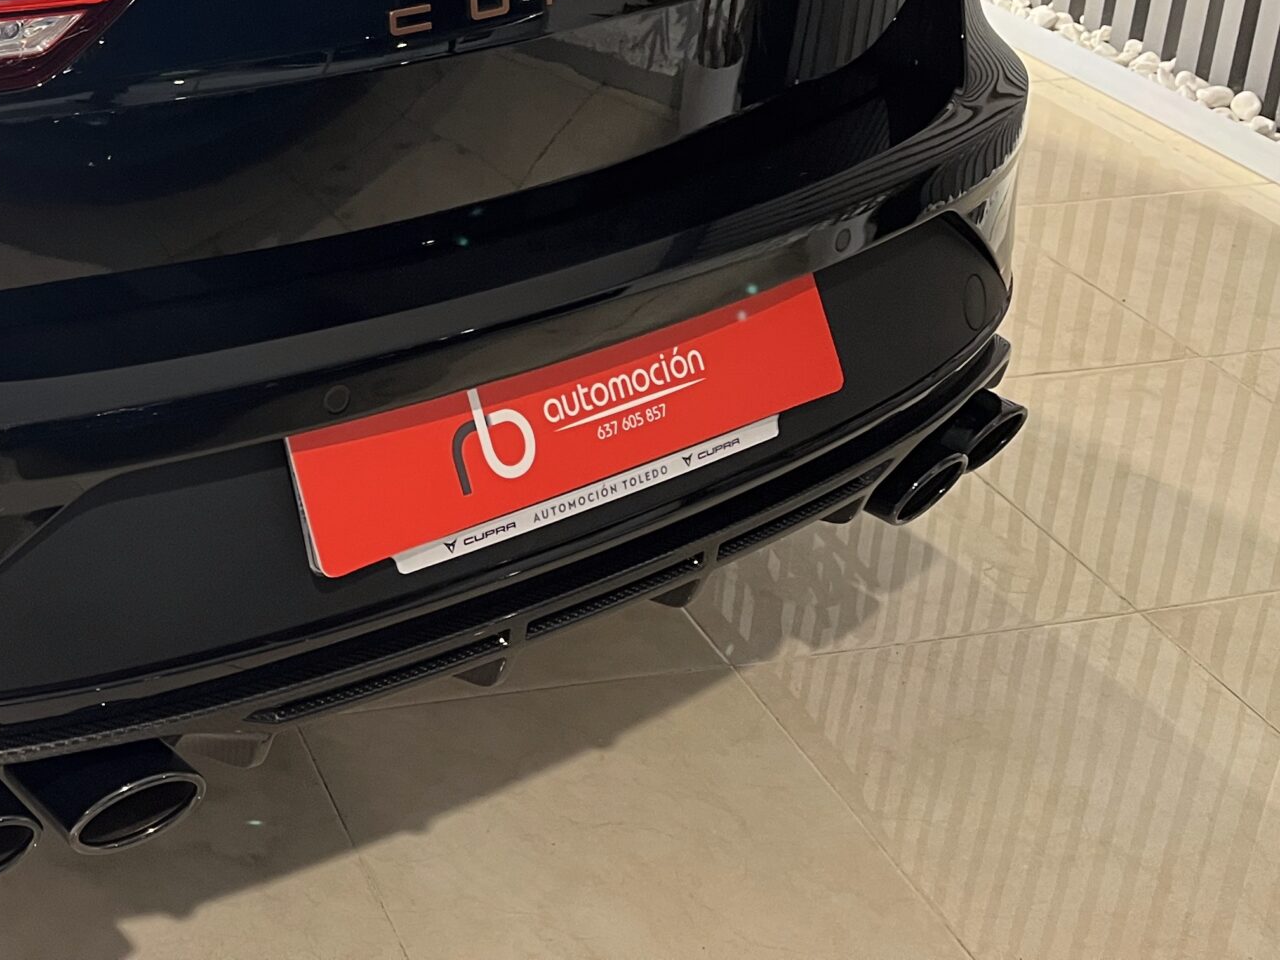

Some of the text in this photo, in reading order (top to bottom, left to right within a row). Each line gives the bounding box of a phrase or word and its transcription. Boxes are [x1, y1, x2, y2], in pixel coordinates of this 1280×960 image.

[543, 346, 705, 423] automoción
[596, 403, 668, 440] 637 605 857
[463, 437, 741, 546] CUPRA AUTOMOCIÓN TOLEDO CUPRA
